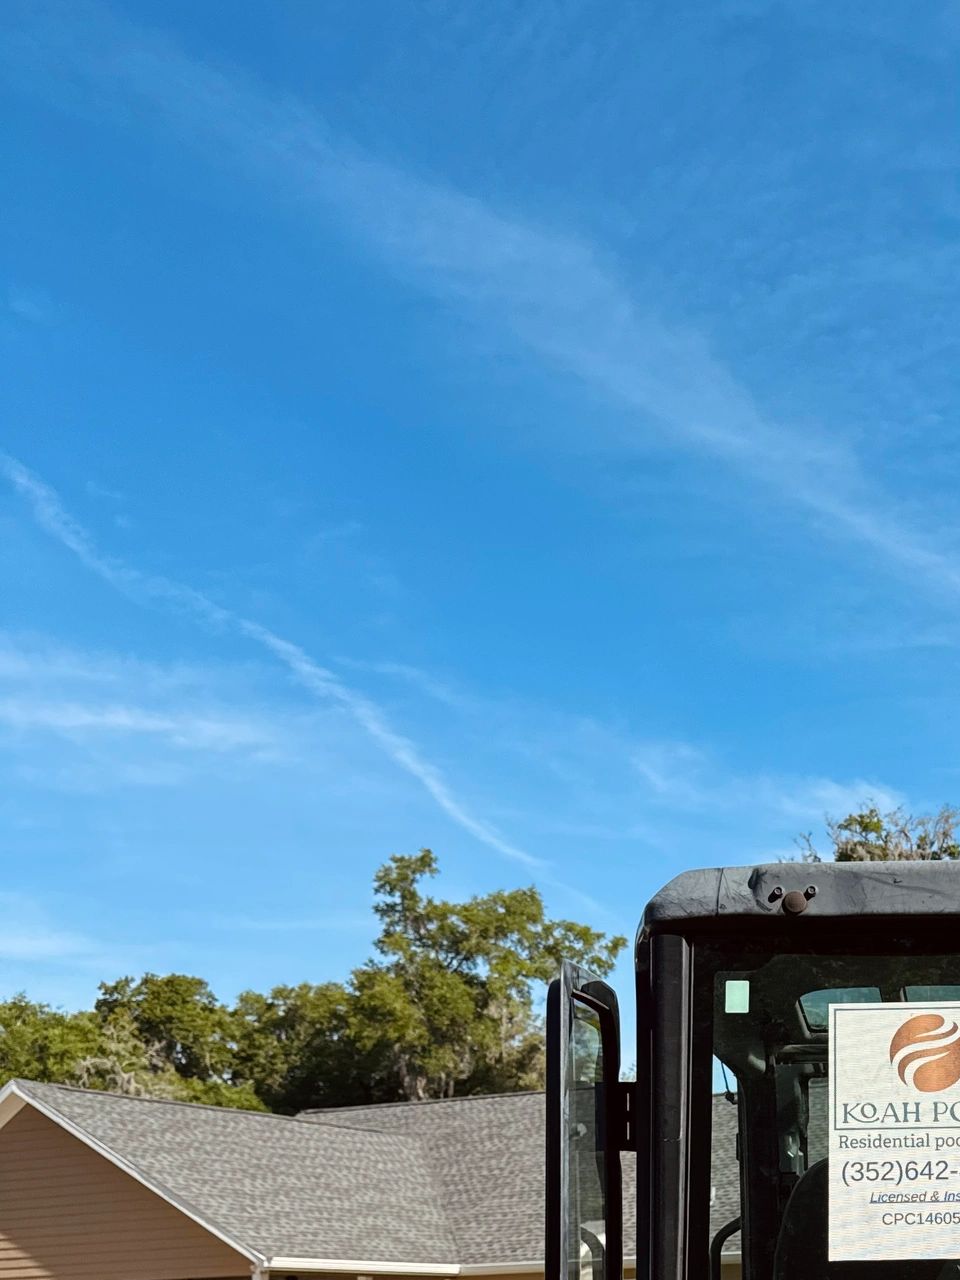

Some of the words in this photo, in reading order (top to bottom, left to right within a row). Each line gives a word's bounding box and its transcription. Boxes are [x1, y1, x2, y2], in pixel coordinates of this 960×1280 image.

[842, 1102, 920, 1124] KOAH
[839, 1133, 930, 1149] Residential
[870, 1191, 926, 1204] Licensed
[930, 1191, 940, 1203] &
